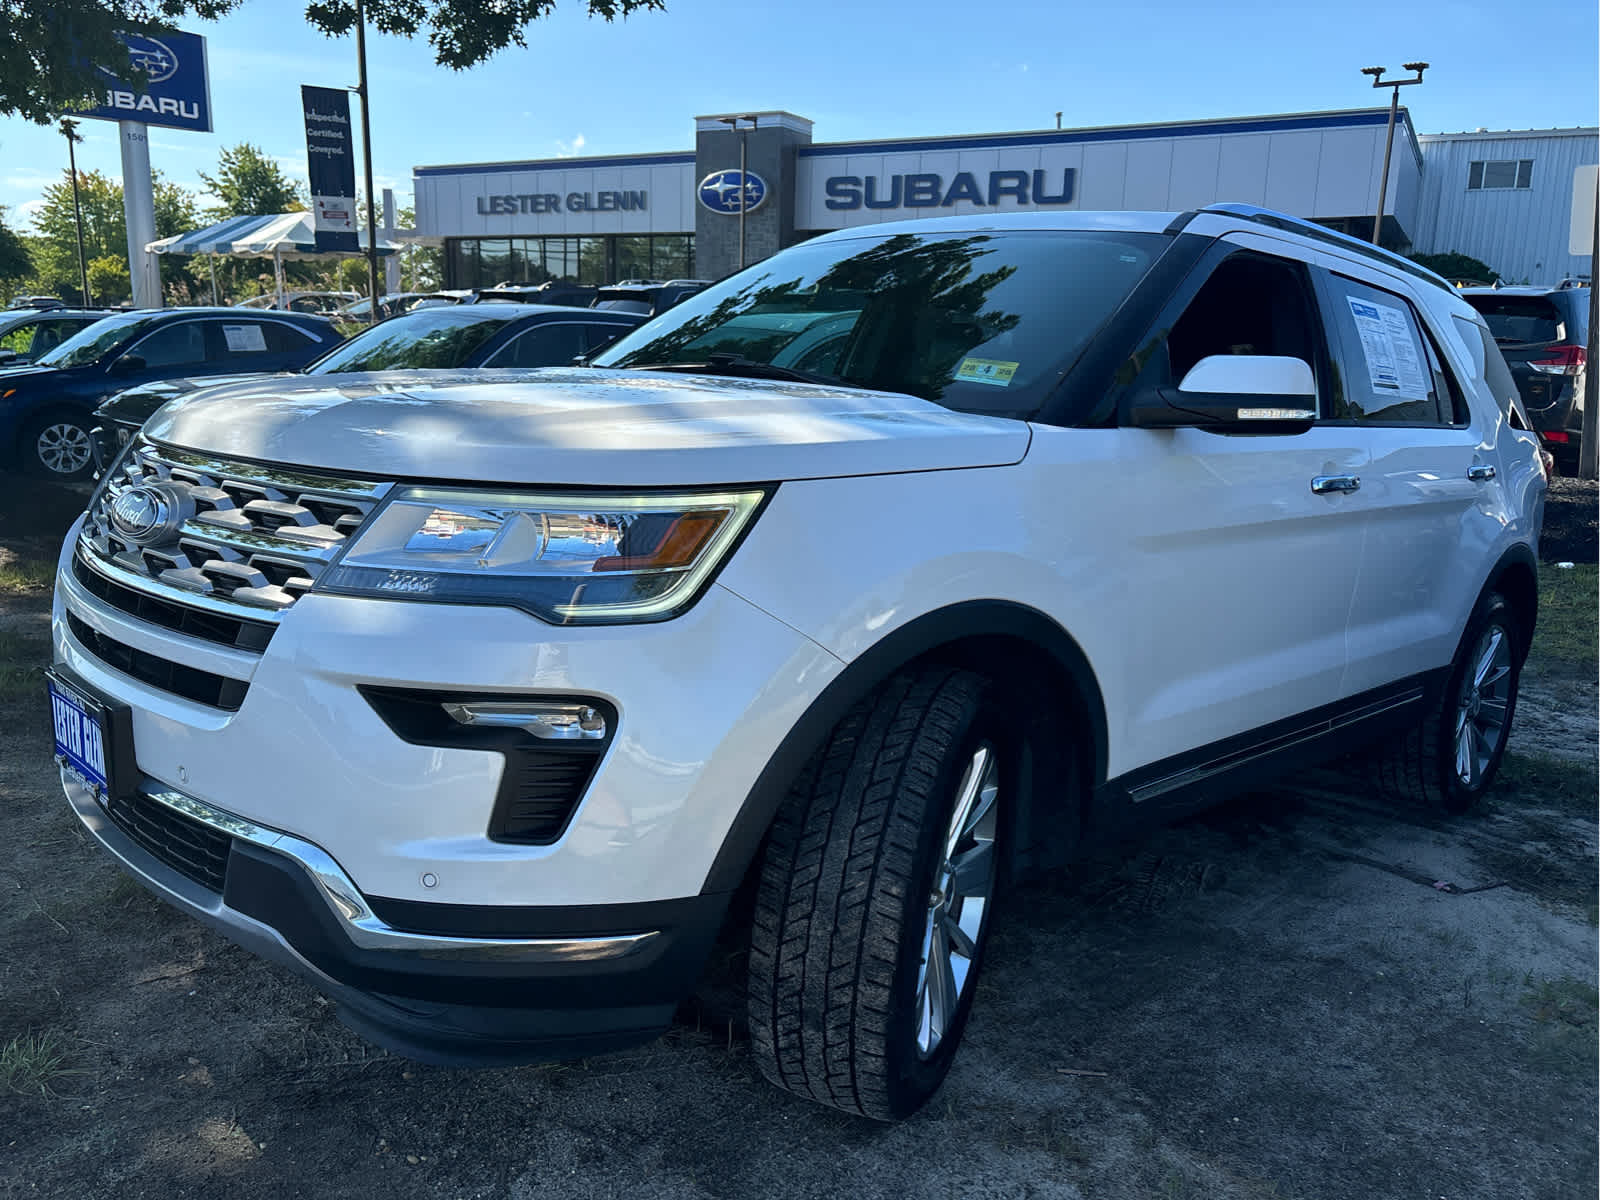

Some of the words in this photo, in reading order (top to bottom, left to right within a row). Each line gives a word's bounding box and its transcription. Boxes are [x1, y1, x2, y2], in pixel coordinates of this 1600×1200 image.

[104, 89, 199, 119] BARU
[308, 128, 345, 139] Certified.
[309, 144, 345, 154] Covered.
[825, 167, 1075, 210] SUBARU
[477, 194, 562, 216] LESTER
[566, 190, 648, 213] GLENN
[118, 498, 149, 525] Ford
[51, 694, 82, 758] LESTER
